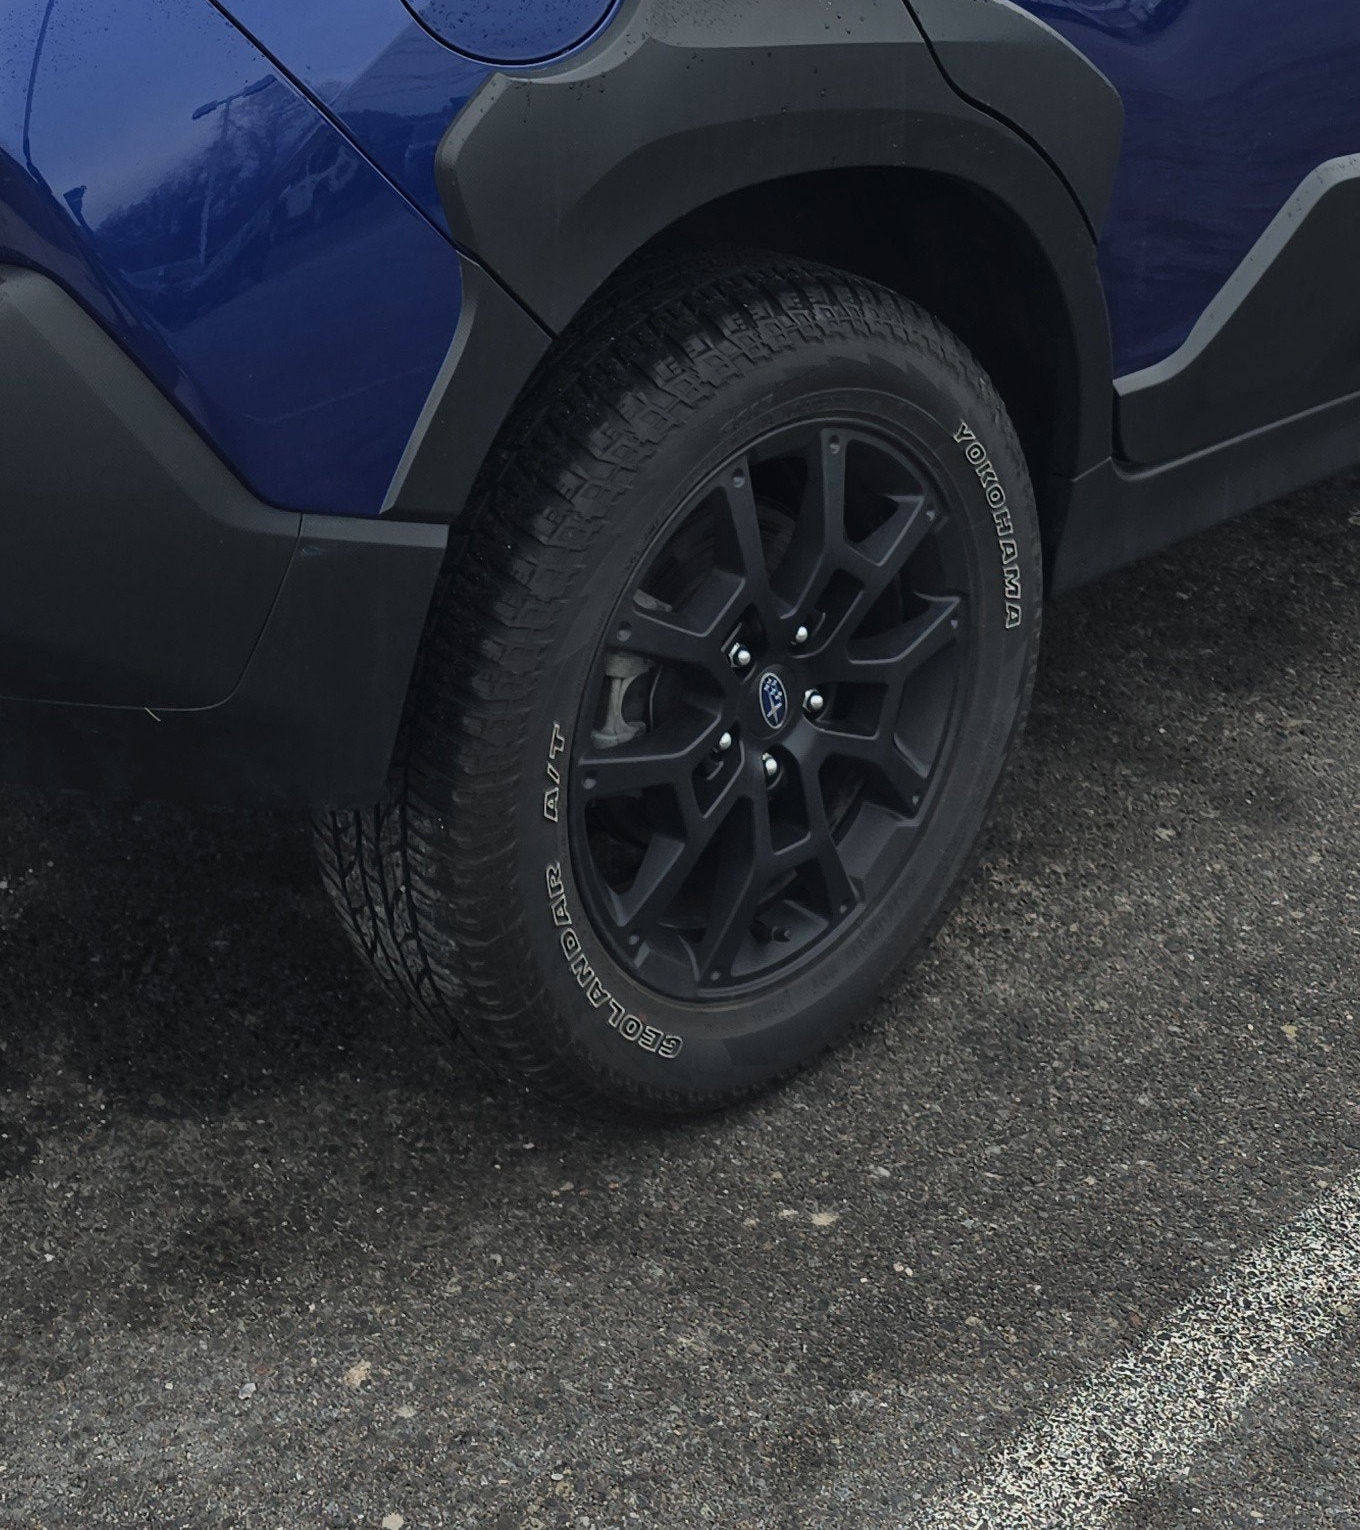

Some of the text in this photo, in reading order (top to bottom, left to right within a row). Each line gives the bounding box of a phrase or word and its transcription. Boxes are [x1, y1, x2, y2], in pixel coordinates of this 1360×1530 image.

[953, 422, 1022, 629] YOKOHAMA
[543, 721, 684, 1059] GEOLANDAR A/T
